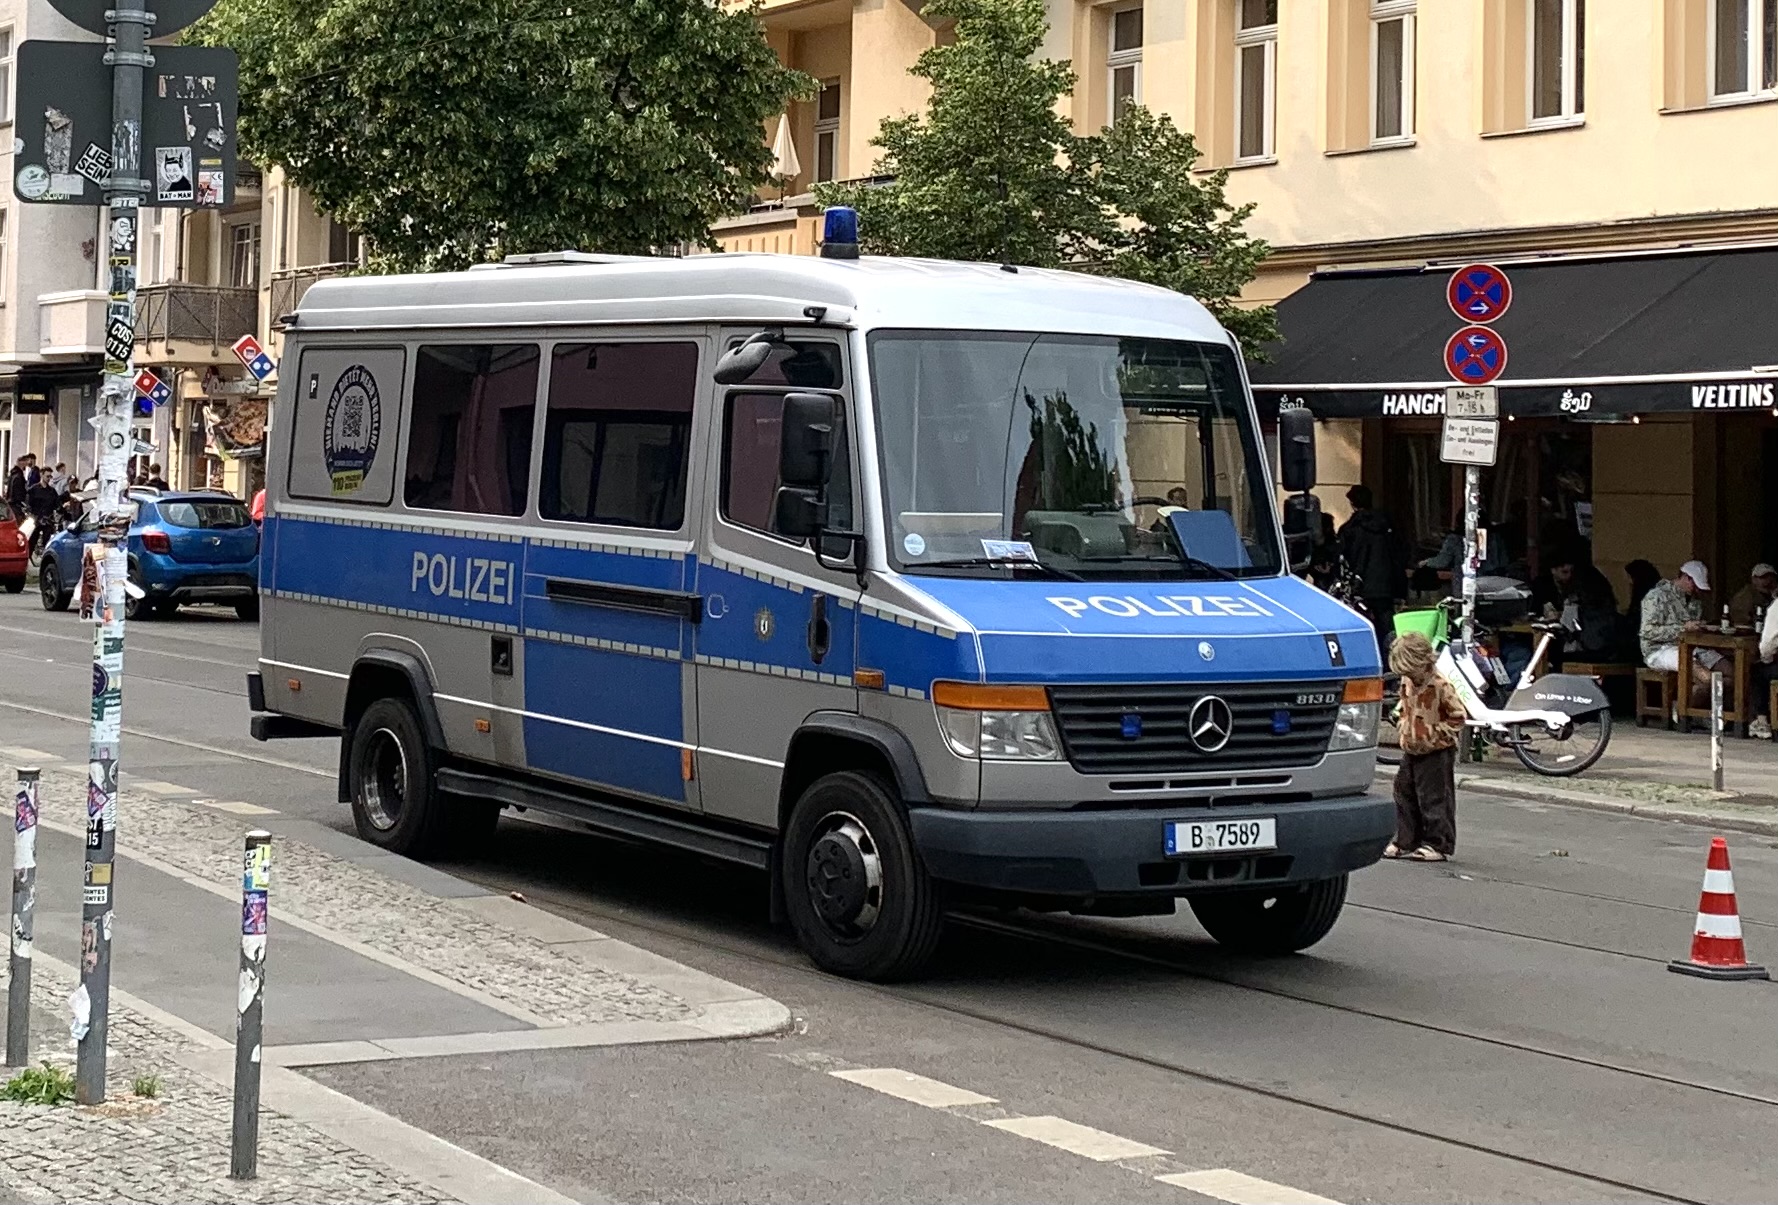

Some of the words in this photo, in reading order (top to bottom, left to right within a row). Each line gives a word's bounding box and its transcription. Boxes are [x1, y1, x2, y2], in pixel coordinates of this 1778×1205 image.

[111, 323, 134, 346] COST
[310, 380, 317, 393] P
[1691, 384, 1774, 408] VELTINS
[411, 551, 515, 605] POLIZEI
[1045, 595, 1274, 618] POLIZEI
[1328, 641, 1338, 659] P
[1296, 694, 1324, 705] 813
[1326, 694, 1336, 704] D
[1192, 825, 1203, 848] B
[1216, 822, 1260, 847] 7589
